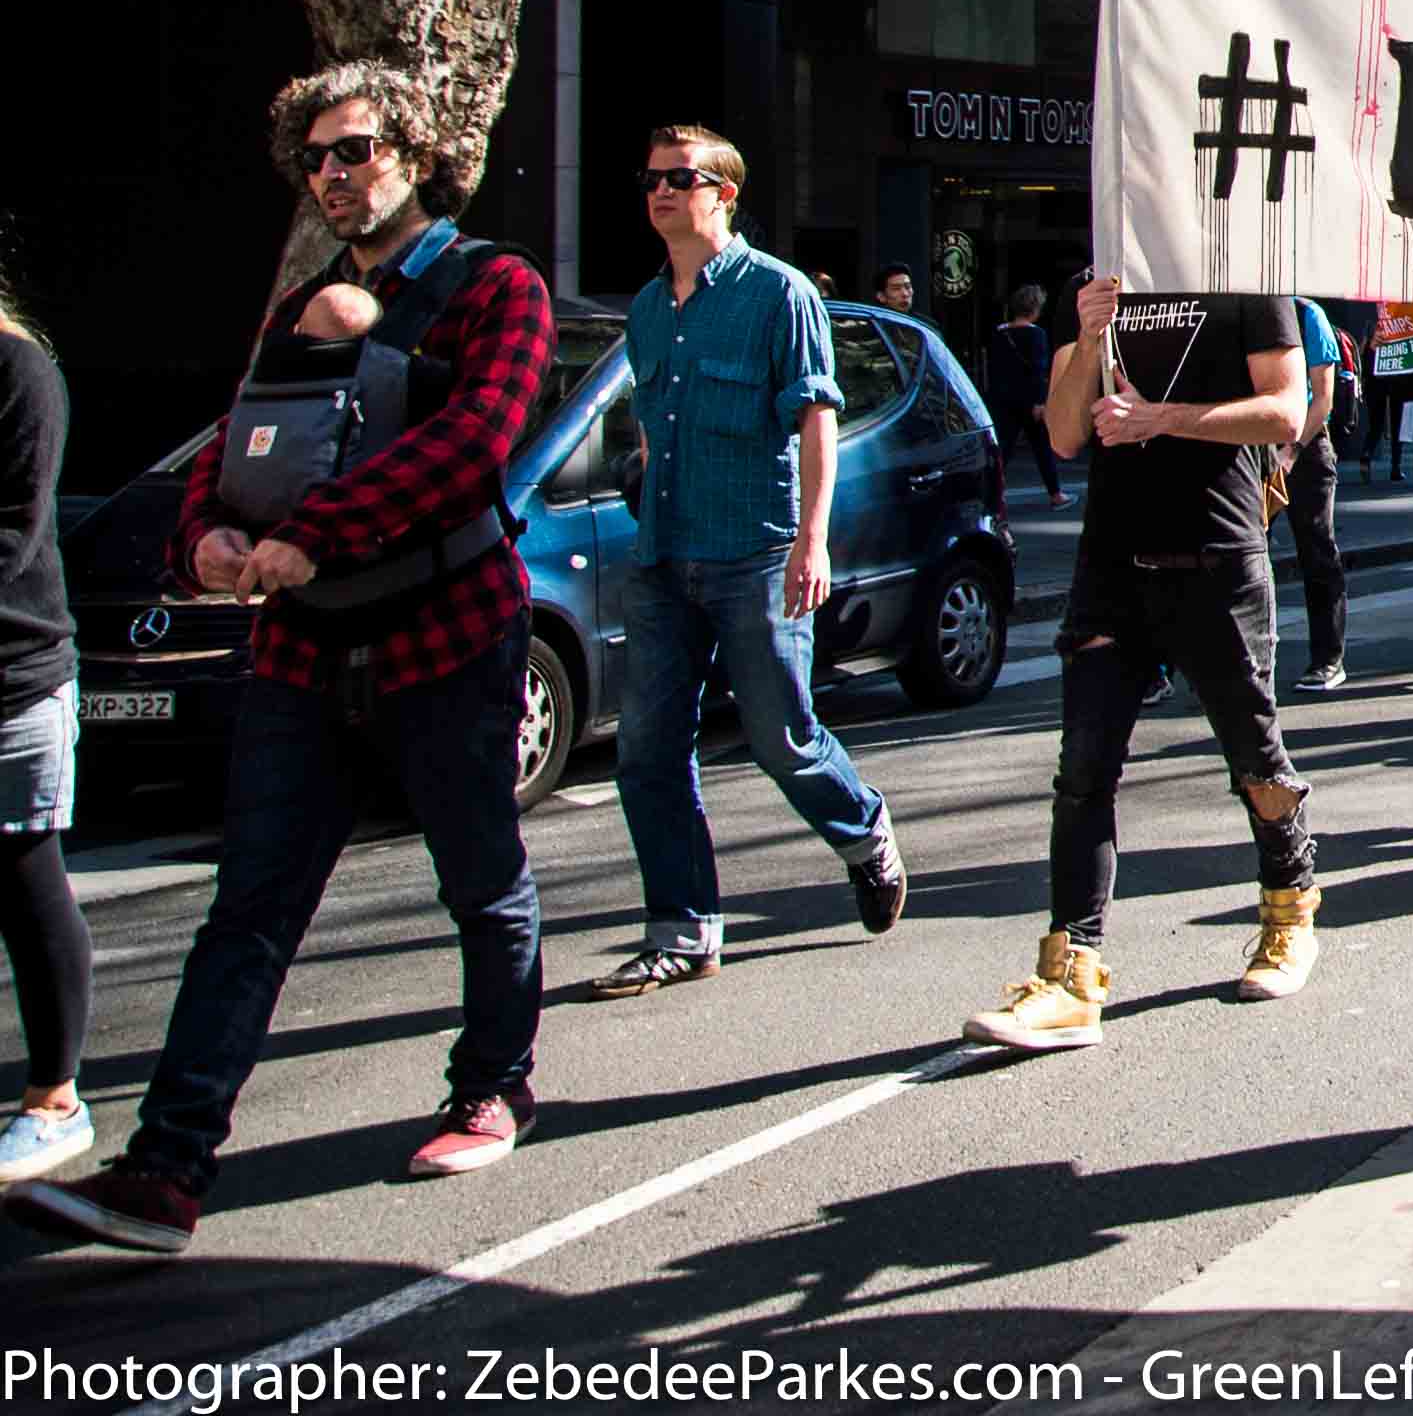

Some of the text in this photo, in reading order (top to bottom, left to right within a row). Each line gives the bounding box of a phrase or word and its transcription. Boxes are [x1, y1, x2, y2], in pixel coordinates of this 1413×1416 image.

[907, 89, 983, 139] TOM
[990, 95, 1011, 141] N
[1120, 300, 1200, 332] NUISANCE
[1380, 342, 1408, 357] BRING
[1379, 357, 1405, 371] HERE
